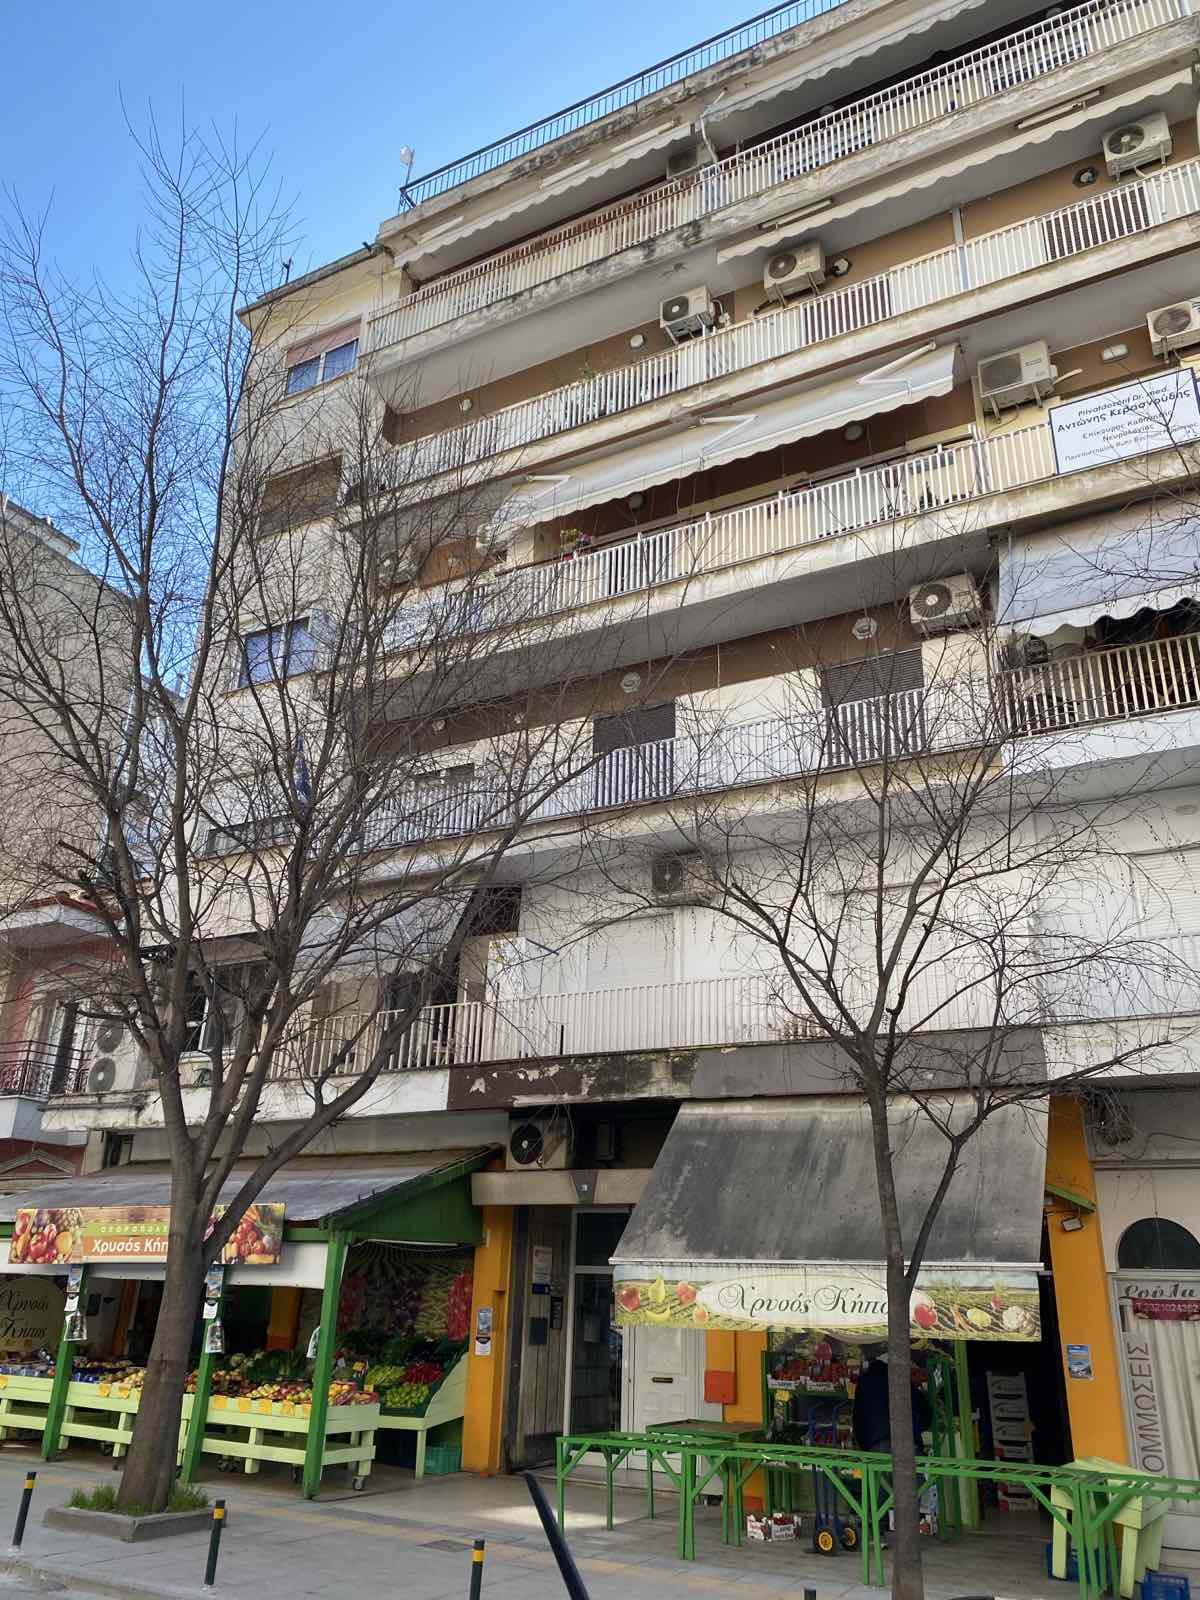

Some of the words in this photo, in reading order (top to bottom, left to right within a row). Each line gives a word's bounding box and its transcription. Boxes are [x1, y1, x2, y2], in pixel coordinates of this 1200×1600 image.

[1057, 413, 1106, 433] Αντώνης
[92, 1238, 141, 1256] Χρυσός
[144, 1237, 169, 1252] Κήπ
[717, 1284, 812, 1318] Χρυσός
[814, 1285, 889, 1314] Κήπο
[1127, 1342, 1166, 1473] ΟΜΜΩΣΕΙΣ
